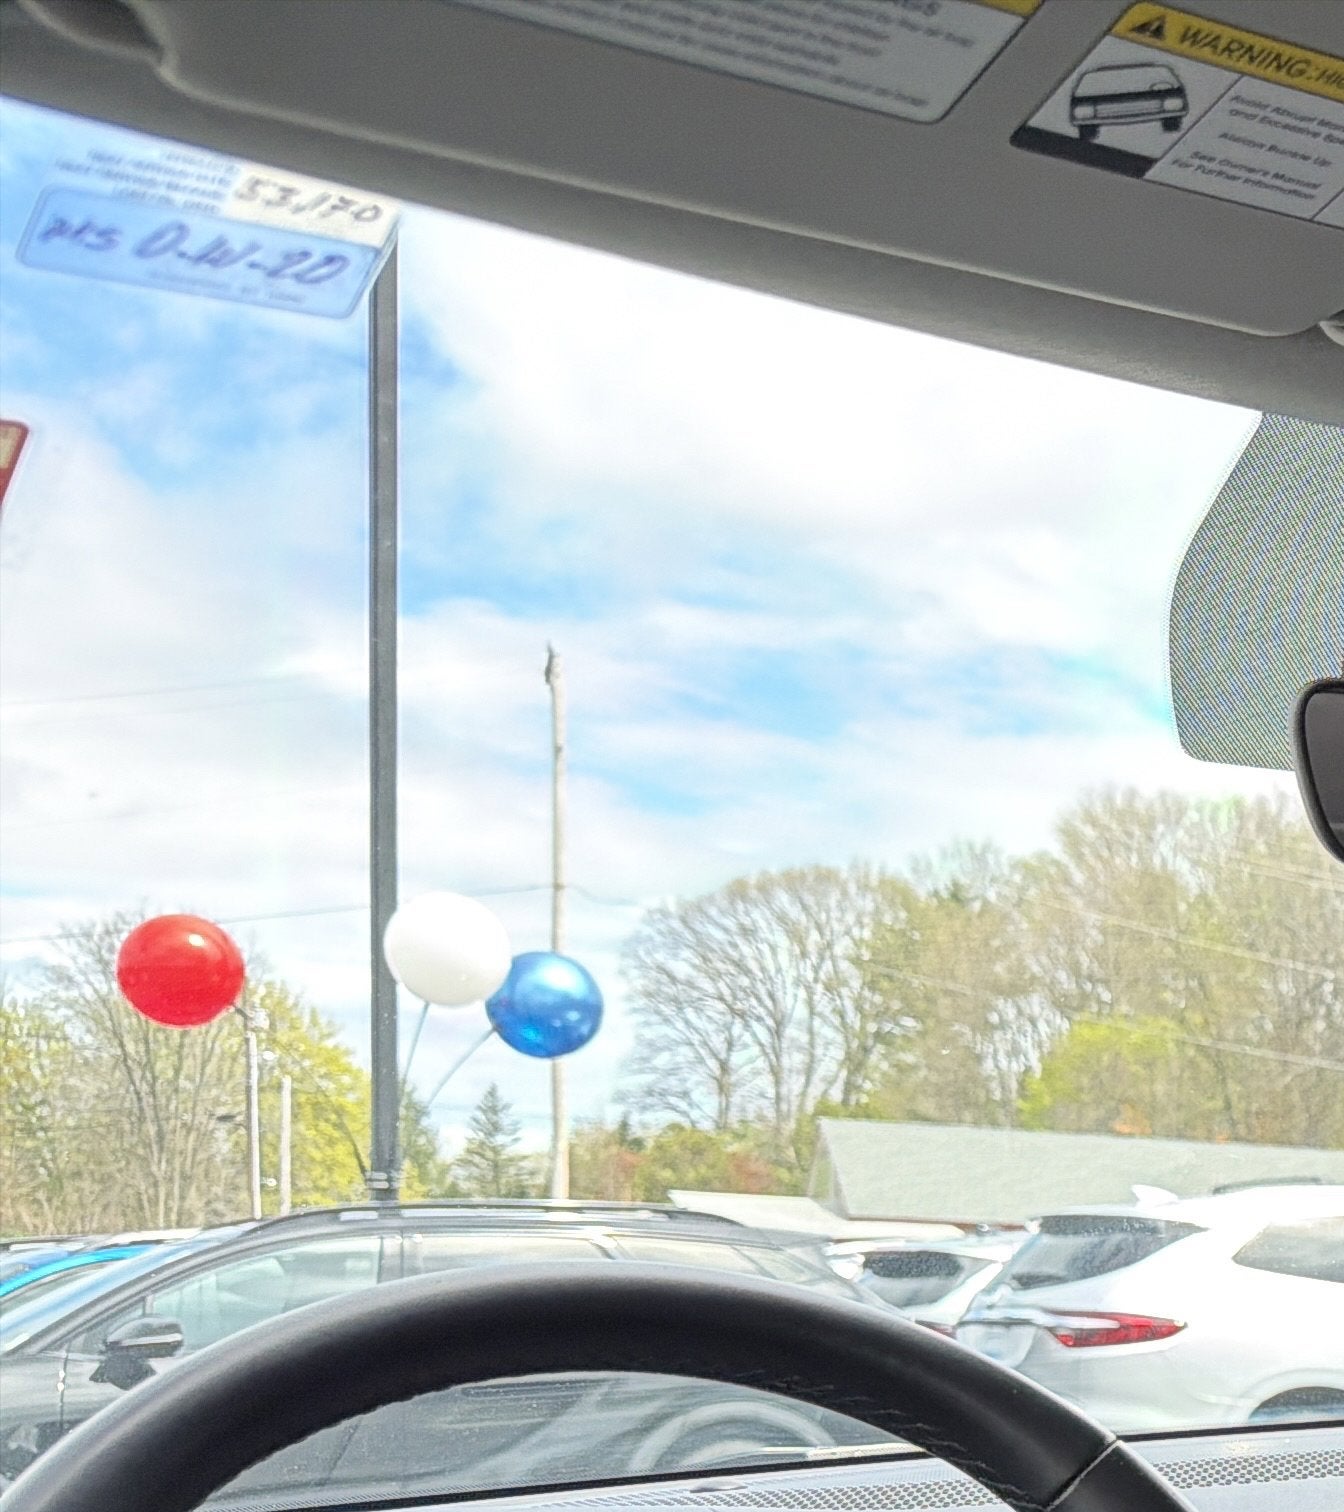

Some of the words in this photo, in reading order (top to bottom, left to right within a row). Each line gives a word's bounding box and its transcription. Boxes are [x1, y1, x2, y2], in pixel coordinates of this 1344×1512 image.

[1229, 108, 1259, 121] and
[1258, 116, 1322, 139] Excessive
[1230, 95, 1271, 111] Avoid
[1270, 106, 1317, 123] Abrupt
[1218, 132, 1266, 151] Always
[1267, 144, 1312, 162] Buckle
[1312, 156, 1333, 168] Up
[1171, 158, 1194, 170] For
[1194, 164, 1242, 183] Further
[1241, 177, 1317, 200] Information
[1190, 151, 1217, 163] See
[1270, 171, 1323, 191] Manual
